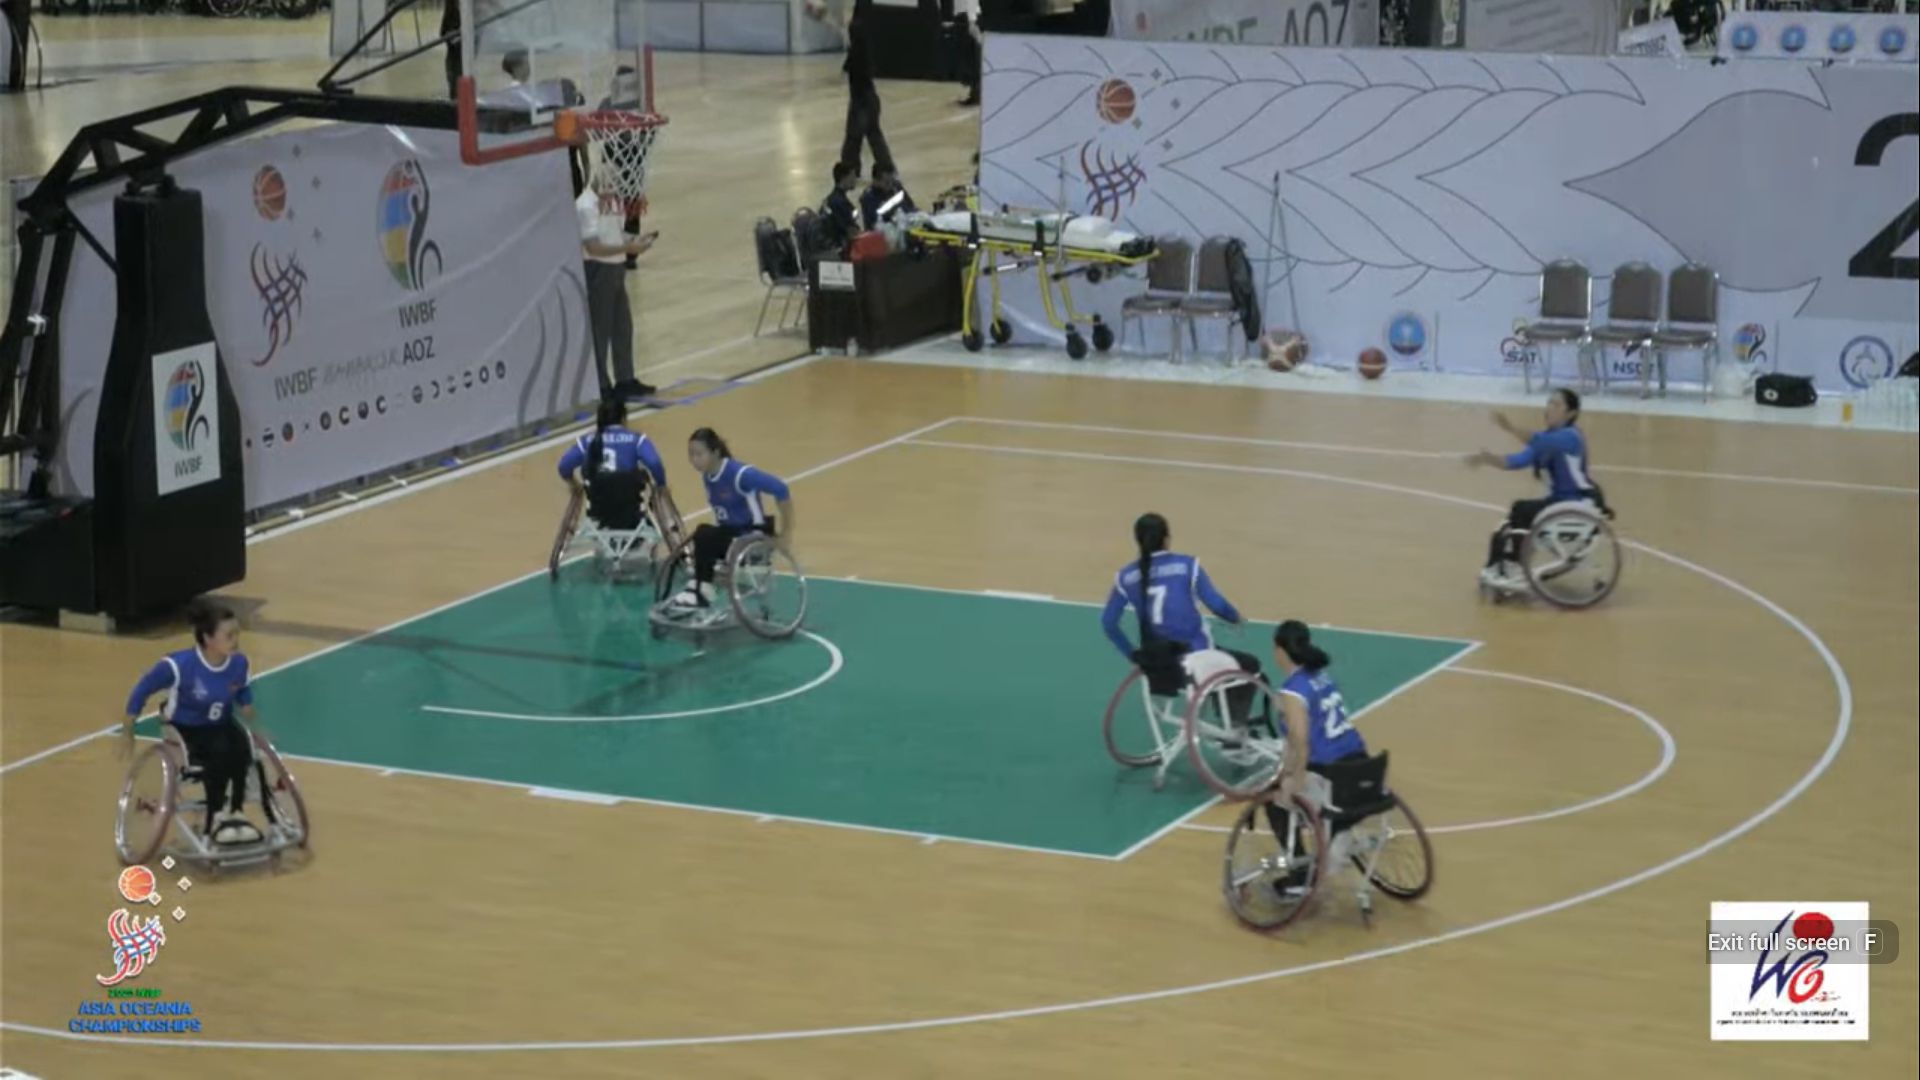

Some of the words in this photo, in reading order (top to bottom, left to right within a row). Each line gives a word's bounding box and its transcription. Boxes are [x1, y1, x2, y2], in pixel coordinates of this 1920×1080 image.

[399, 300, 436, 328] IWBF
[402, 336, 435, 365] AOZ
[274, 367, 317, 401] IWBF
[1147, 585, 1167, 624] 7
[208, 702, 224, 720] 6
